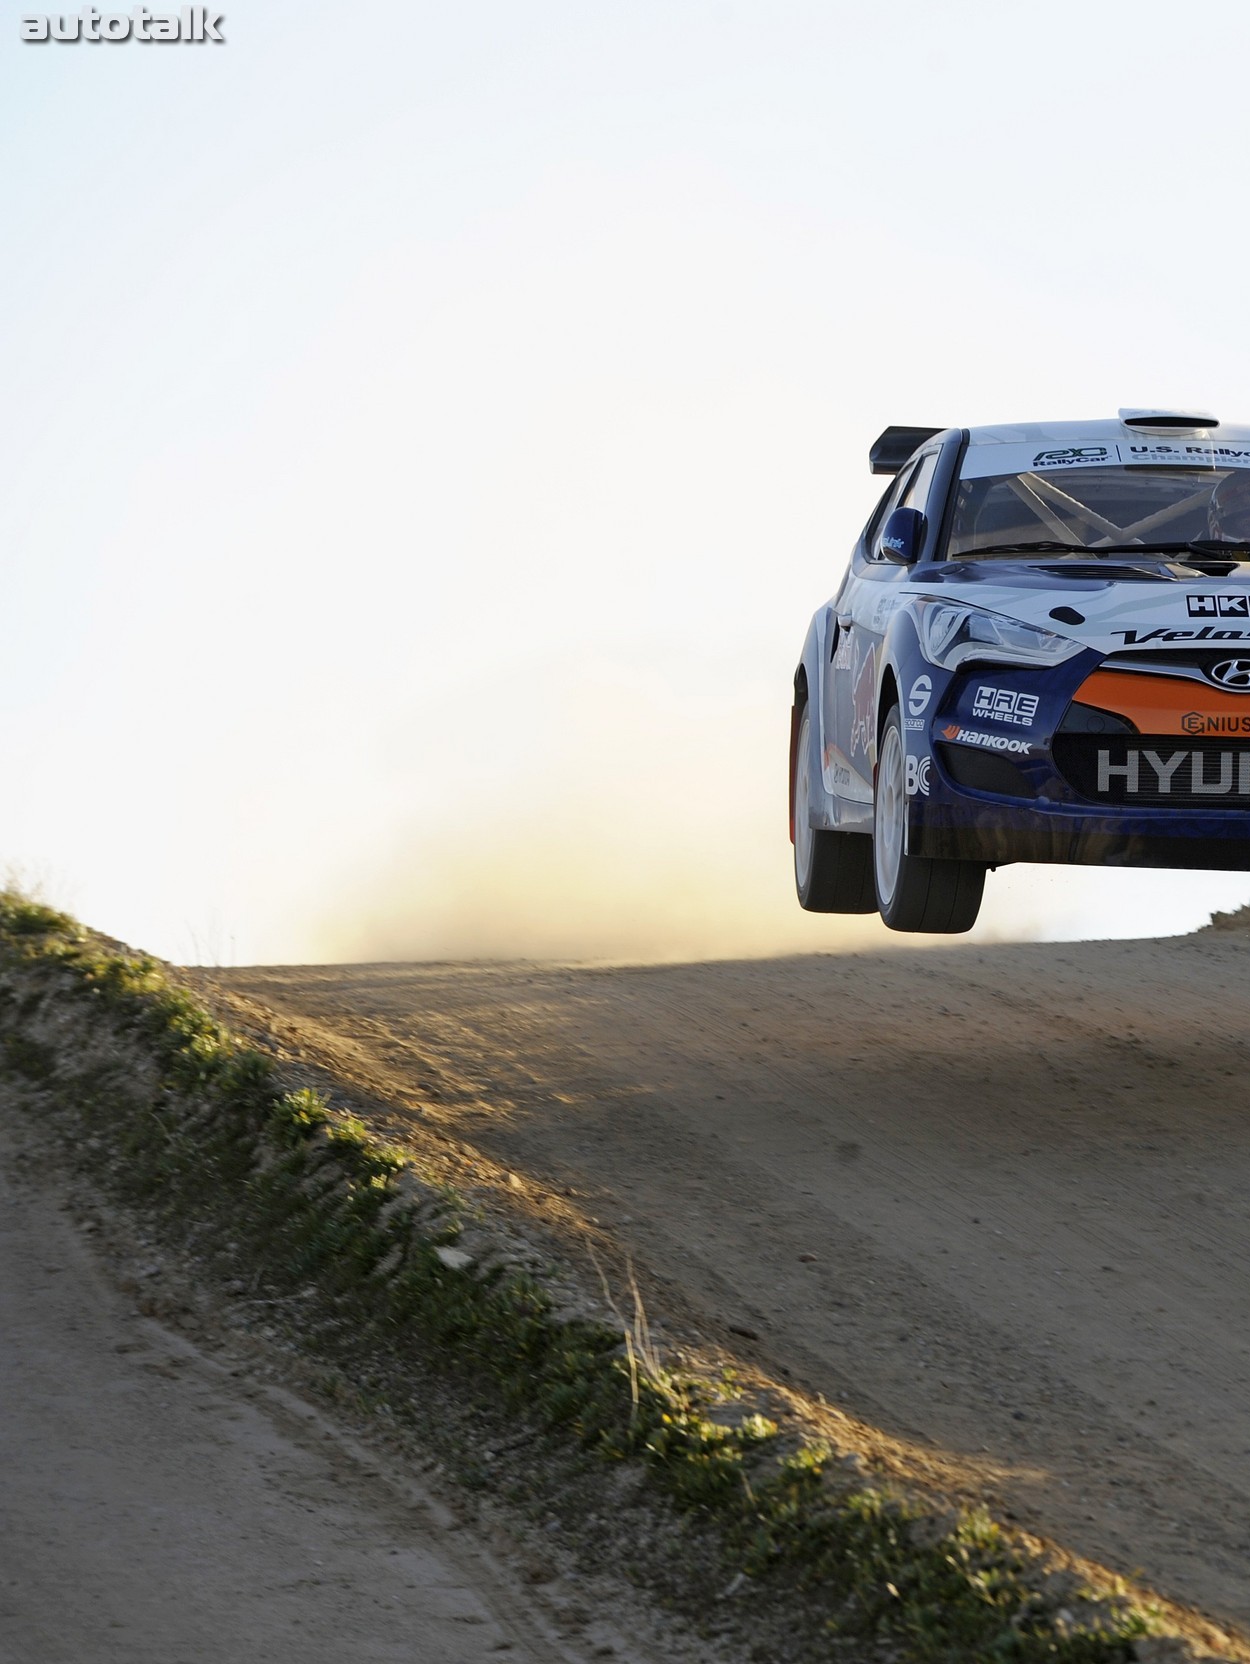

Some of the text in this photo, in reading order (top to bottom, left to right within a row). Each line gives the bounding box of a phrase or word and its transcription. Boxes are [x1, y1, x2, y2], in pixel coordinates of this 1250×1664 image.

[1033, 456, 1107, 467] RallyCar
[973, 686, 1040, 717] HRE
[972, 708, 1033, 727] WHEELS
